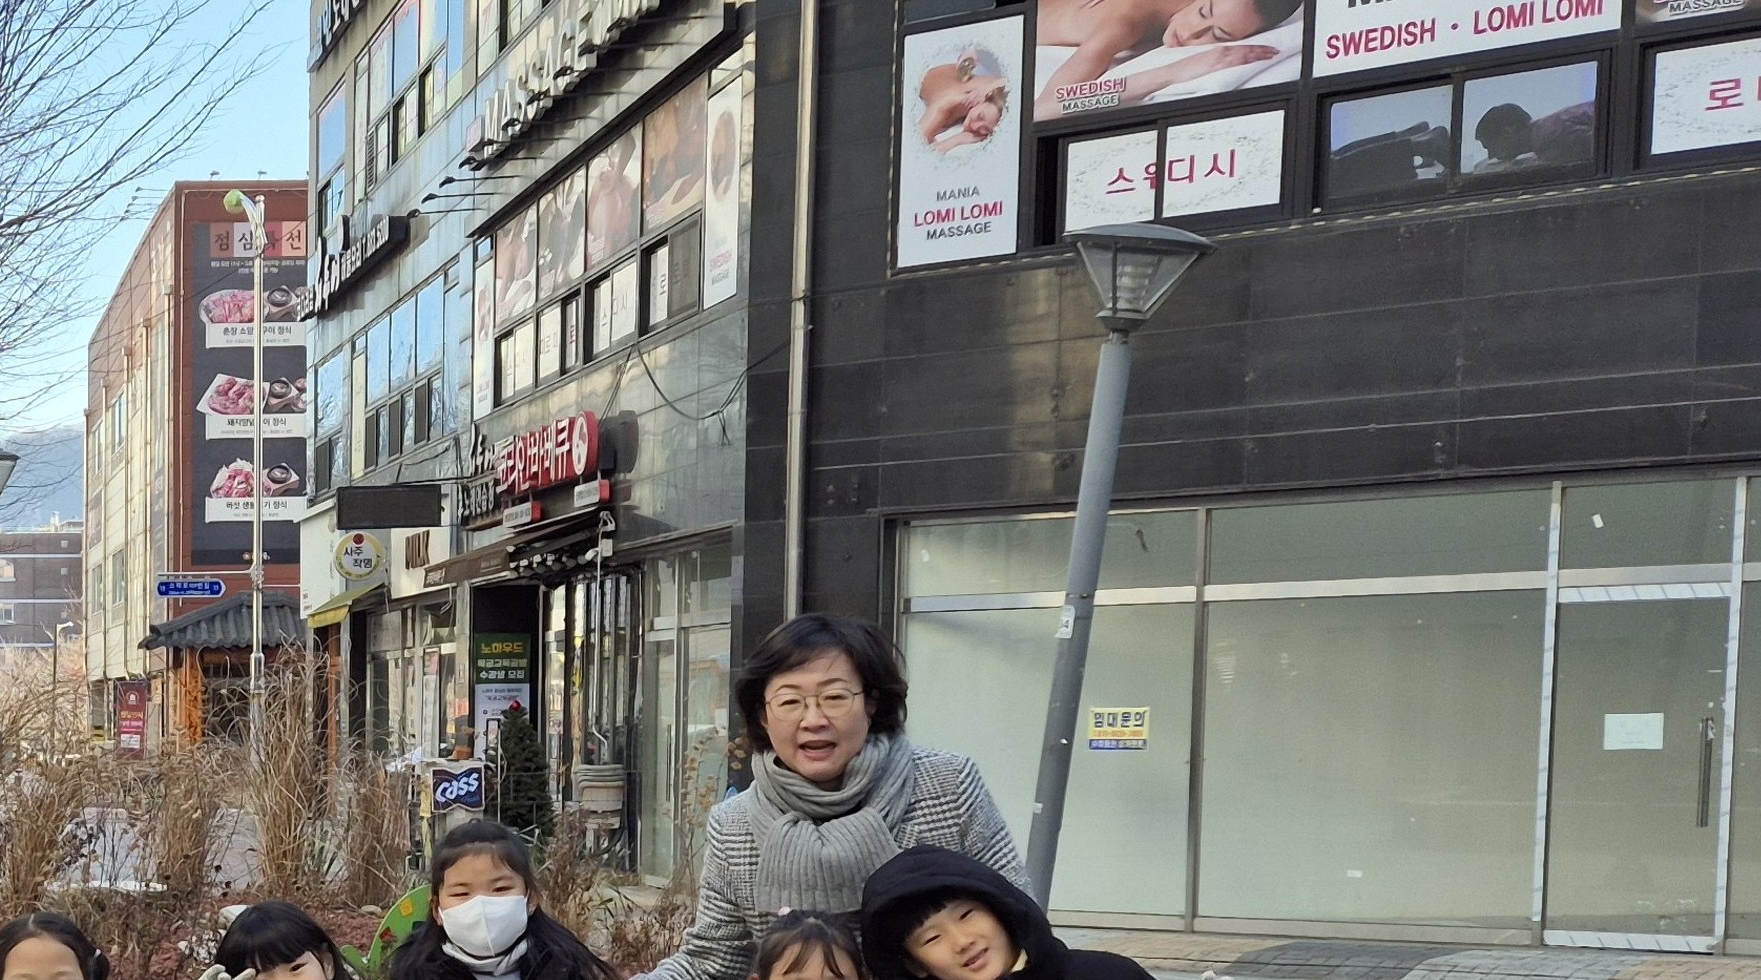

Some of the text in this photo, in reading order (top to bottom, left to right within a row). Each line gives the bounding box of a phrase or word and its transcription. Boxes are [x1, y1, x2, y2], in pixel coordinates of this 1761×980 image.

[1326, 17, 1436, 59] SWEDISH
[1473, 1, 1535, 35] LOMI
[483, 8, 598, 159] MASSAGE
[1055, 77, 1126, 101] SWEDISH
[1704, 76, 1761, 111] 로
[1062, 95, 1119, 112] MASSAGE
[936, 185, 980, 202] MANIA
[914, 200, 1003, 227] LOMI LOMI
[926, 221, 992, 240] MASSAGE
[343, 546, 364, 557] 사주
[353, 558, 373, 569] 작명
[507, 670, 525, 679] 모집
[1094, 710, 1147, 728] 임대문의
